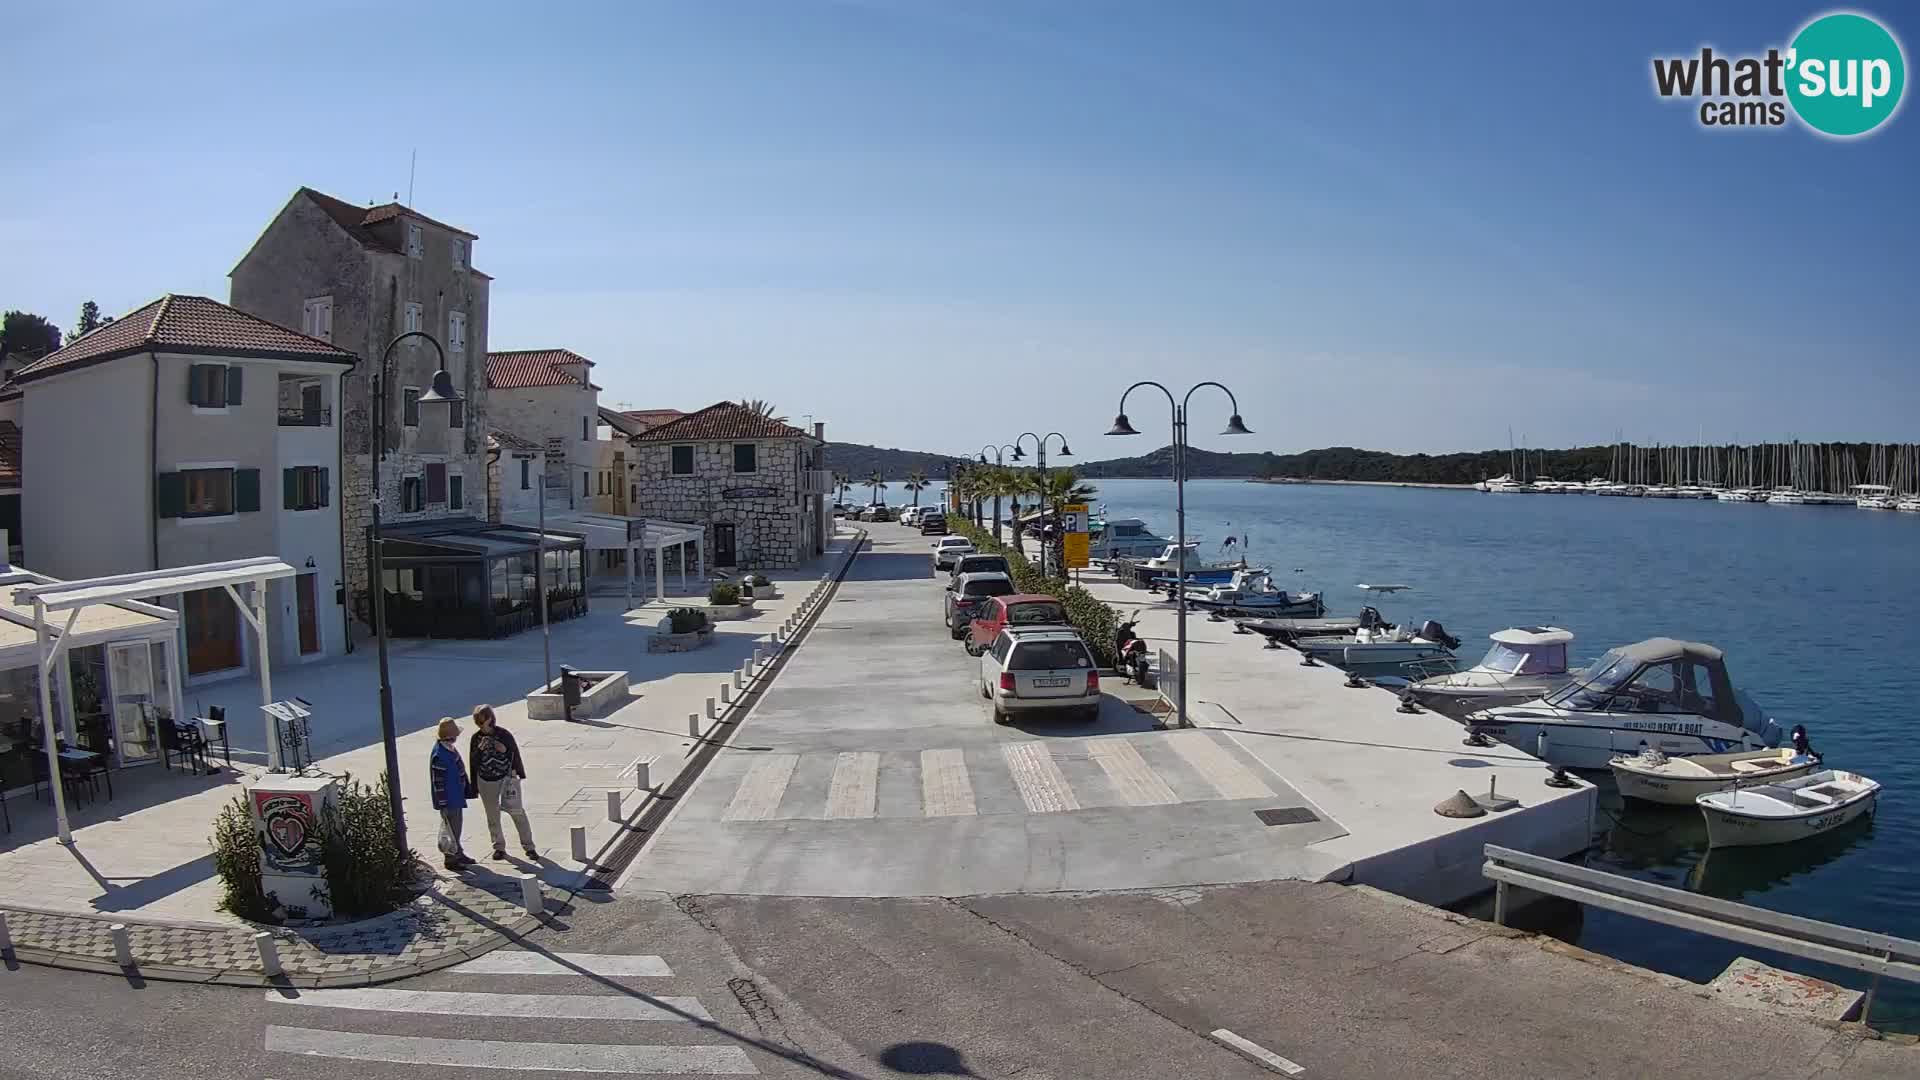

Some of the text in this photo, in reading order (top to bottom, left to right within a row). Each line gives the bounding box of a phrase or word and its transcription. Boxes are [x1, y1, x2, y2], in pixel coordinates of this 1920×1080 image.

[1065, 515, 1076, 530] P
[1657, 722, 1678, 732] RENT
[1684, 723, 1704, 734] BOAT
